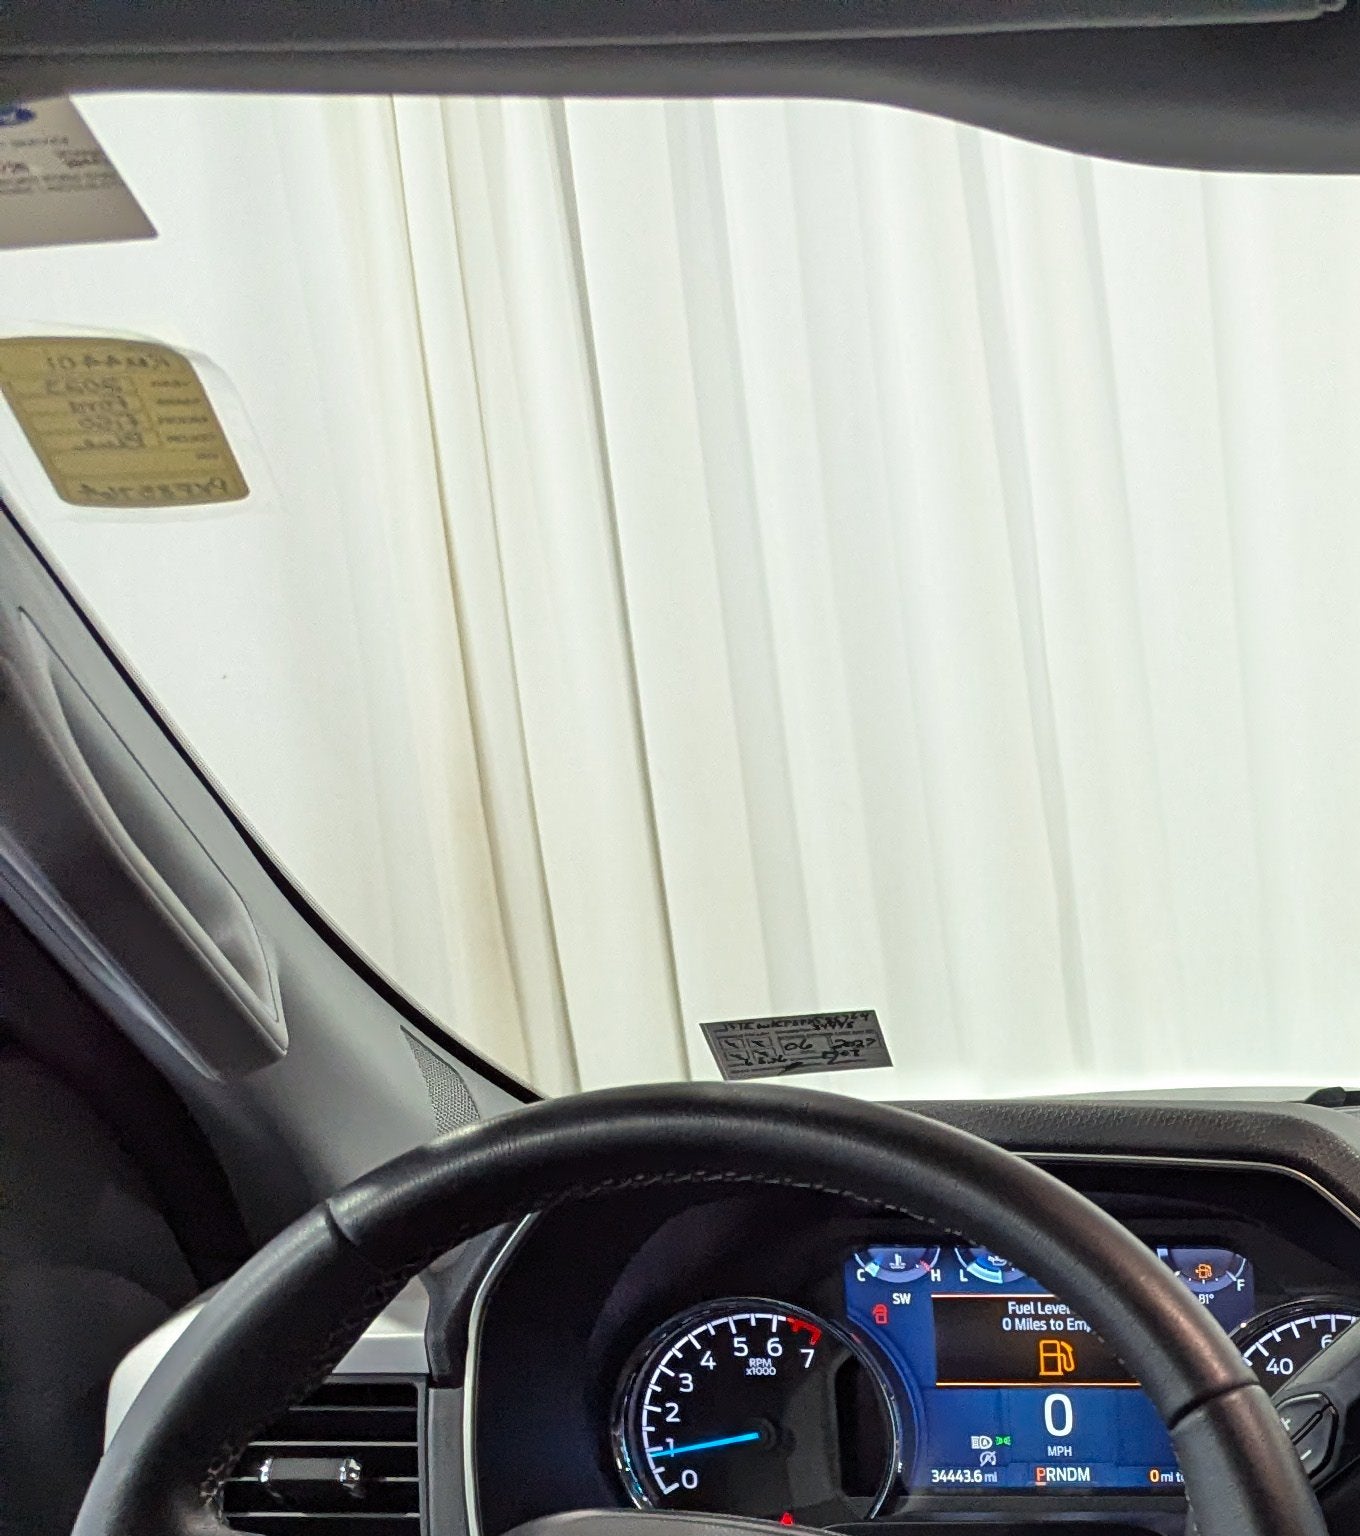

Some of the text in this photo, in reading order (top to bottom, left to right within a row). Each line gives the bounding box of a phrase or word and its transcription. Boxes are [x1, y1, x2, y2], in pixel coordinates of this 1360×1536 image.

[856, 1269, 866, 1282] C
[930, 1269, 941, 1282] H
[959, 1269, 968, 1282] L
[1236, 1279, 1245, 1292] F
[892, 1293, 911, 1305] SW
[1008, 1302, 1033, 1316] Fuel
[1003, 1318, 1012, 1331] 0
[1015, 1317, 1046, 1331] Miles
[1050, 1318, 1063, 1331] to
[733, 1337, 748, 1357] 5
[766, 1338, 783, 1357] 6
[700, 1351, 717, 1370] 4
[749, 1358, 772, 1368] RPM
[800, 1349, 815, 1369] 7
[745, 1367, 776, 1376] x1000
[1265, 1358, 1293, 1375] 40
[679, 1374, 694, 1393] 3
[665, 1403, 680, 1422] 2
[1044, 1393, 1073, 1437] 0
[665, 1439, 675, 1457] 1
[1047, 1446, 1072, 1457] MPH
[681, 1470, 698, 1489] 0
[931, 1469, 997, 1483] 34443.6 mi
[1035, 1467, 1091, 1483] PRNDM
[1149, 1469, 1159, 1483] 0
